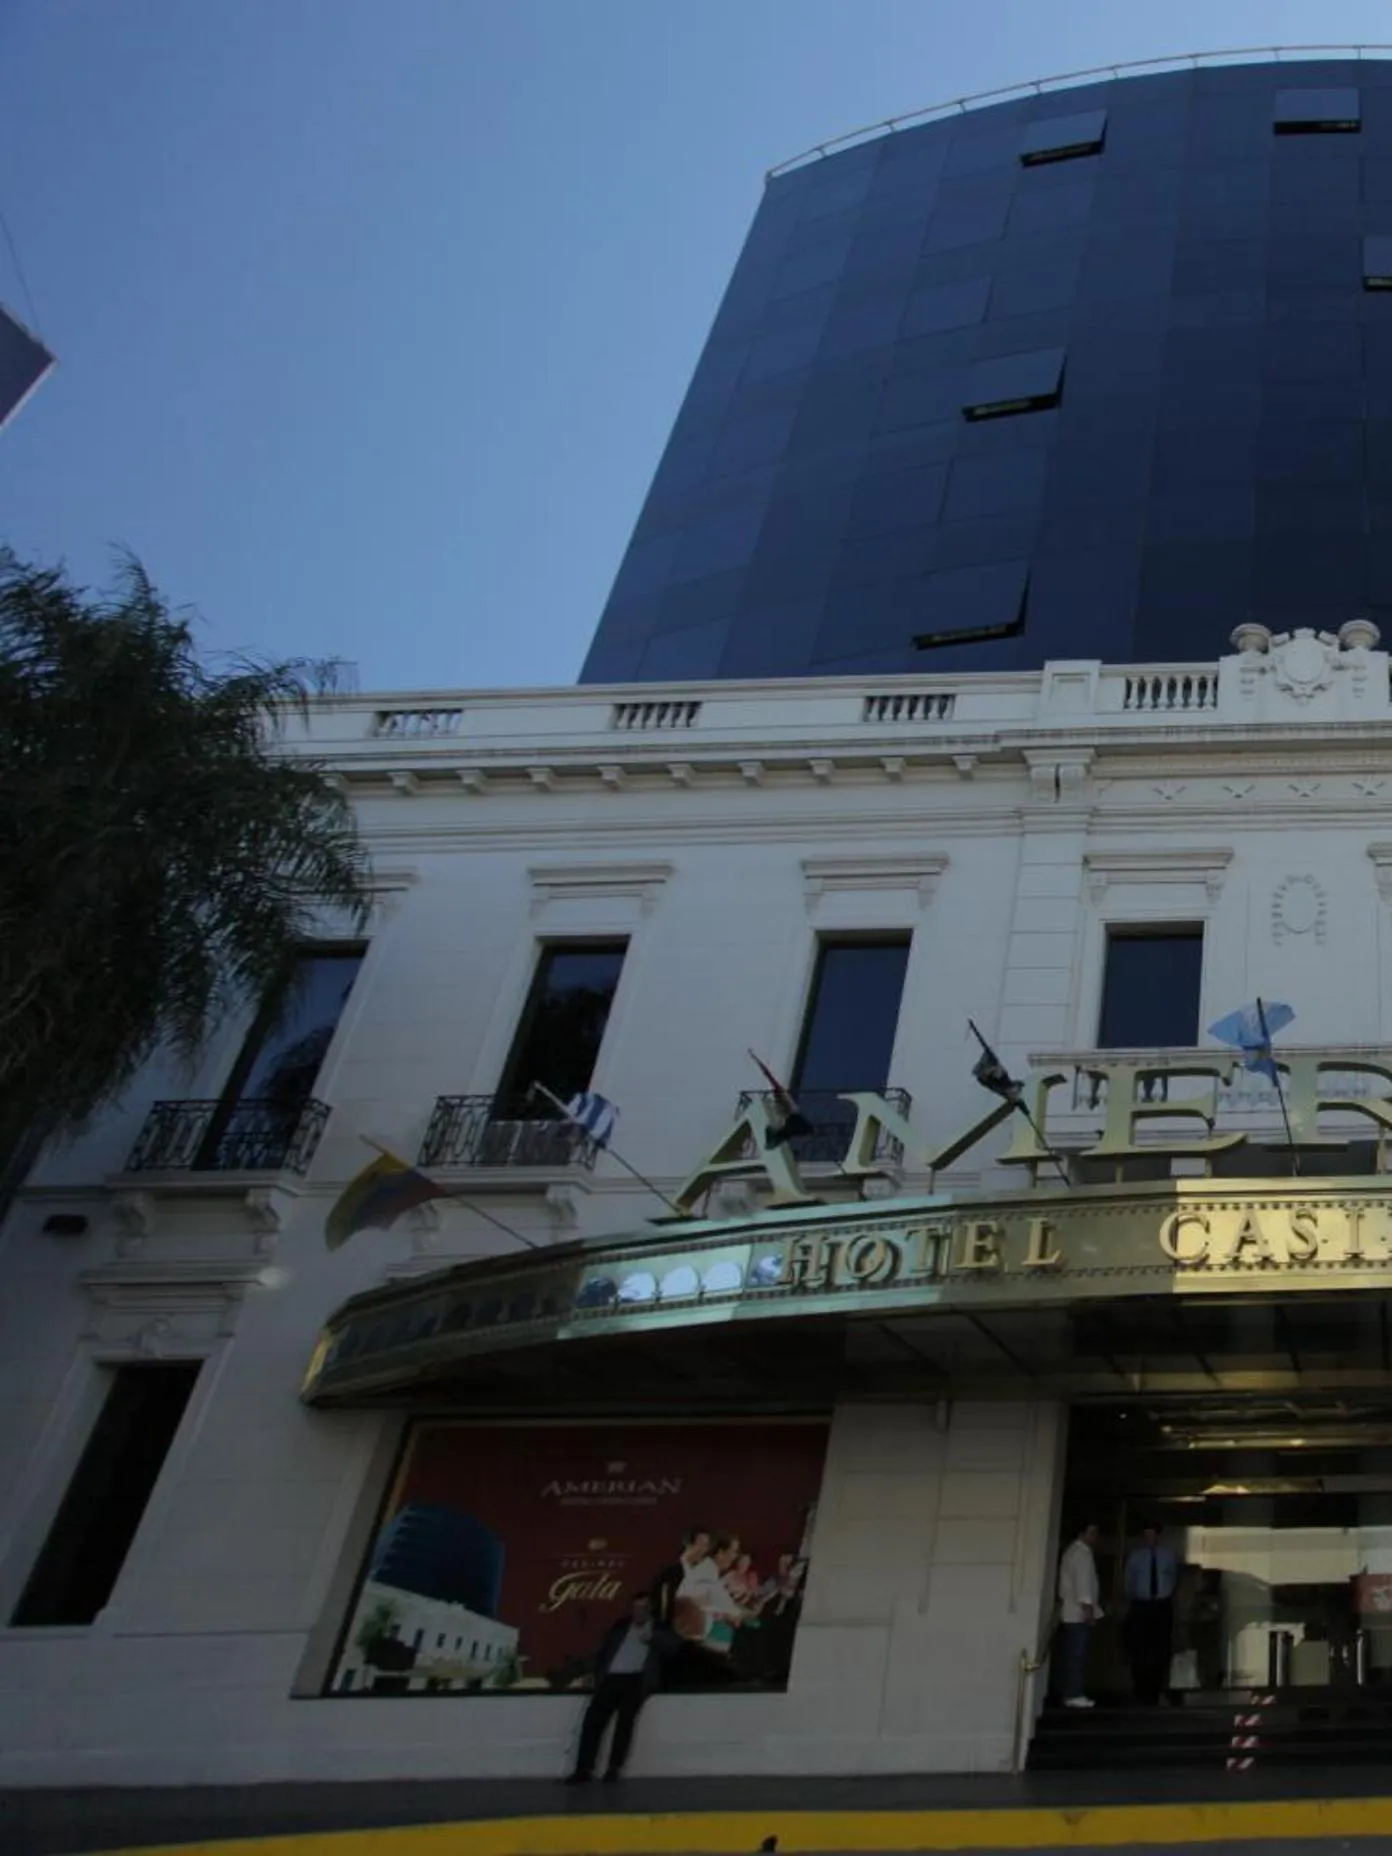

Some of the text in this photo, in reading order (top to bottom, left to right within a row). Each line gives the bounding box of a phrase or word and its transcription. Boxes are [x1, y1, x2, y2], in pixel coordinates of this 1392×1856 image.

[779, 1217, 1062, 1288] HOTEL
[541, 1478, 684, 1497] AMERIAN
[539, 1570, 623, 1613] Gala
